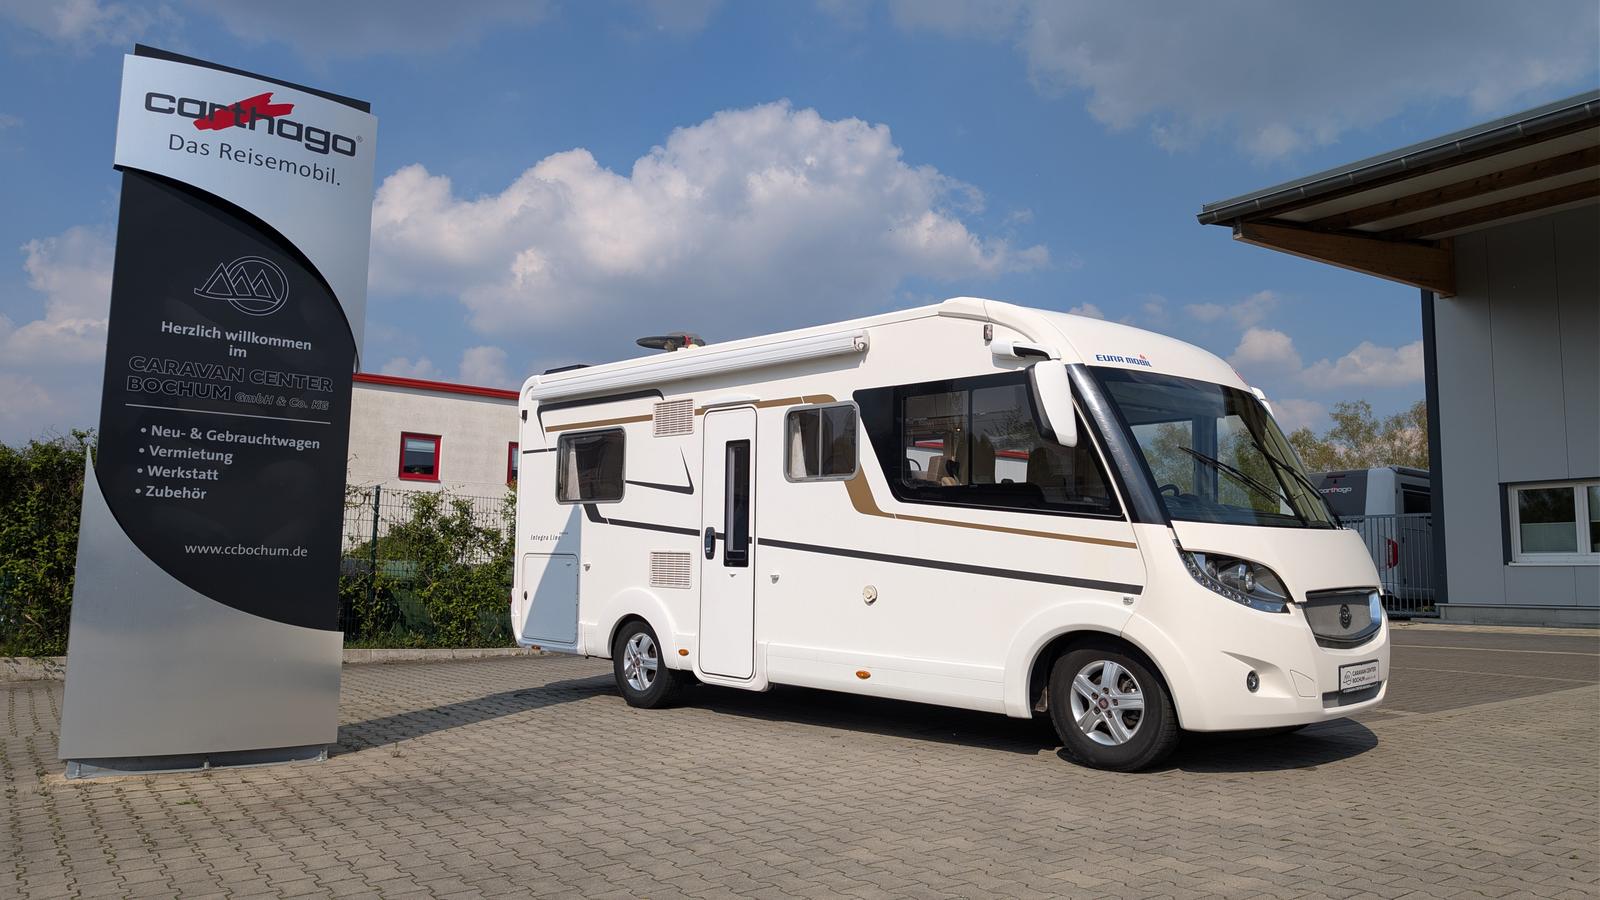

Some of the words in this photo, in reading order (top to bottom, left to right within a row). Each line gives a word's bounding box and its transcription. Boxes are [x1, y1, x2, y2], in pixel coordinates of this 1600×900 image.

[144, 91, 356, 157] carthago
[168, 133, 210, 156] Das
[219, 142, 341, 187] Reisemobil.
[161, 320, 221, 340] Herzlich
[225, 332, 312, 351] willkommen
[228, 345, 247, 358] im
[1095, 354, 1125, 363] EURA
[128, 355, 245, 383] CARAVAN
[249, 369, 334, 393] CENTER
[126, 375, 231, 401] BOCHUM
[234, 391, 275, 405] GmbH
[275, 396, 287, 406] &
[288, 396, 309, 409] Co.
[150, 424, 187, 438] Neu-
[190, 427, 203, 440] &
[206, 429, 321, 452] Gebrauchtwagen
[149, 444, 234, 465] Vermietung
[147, 464, 220, 481] Werkstatt
[145, 485, 207, 500] Zubehör
[184, 543, 308, 558] www.ccbochum.de
